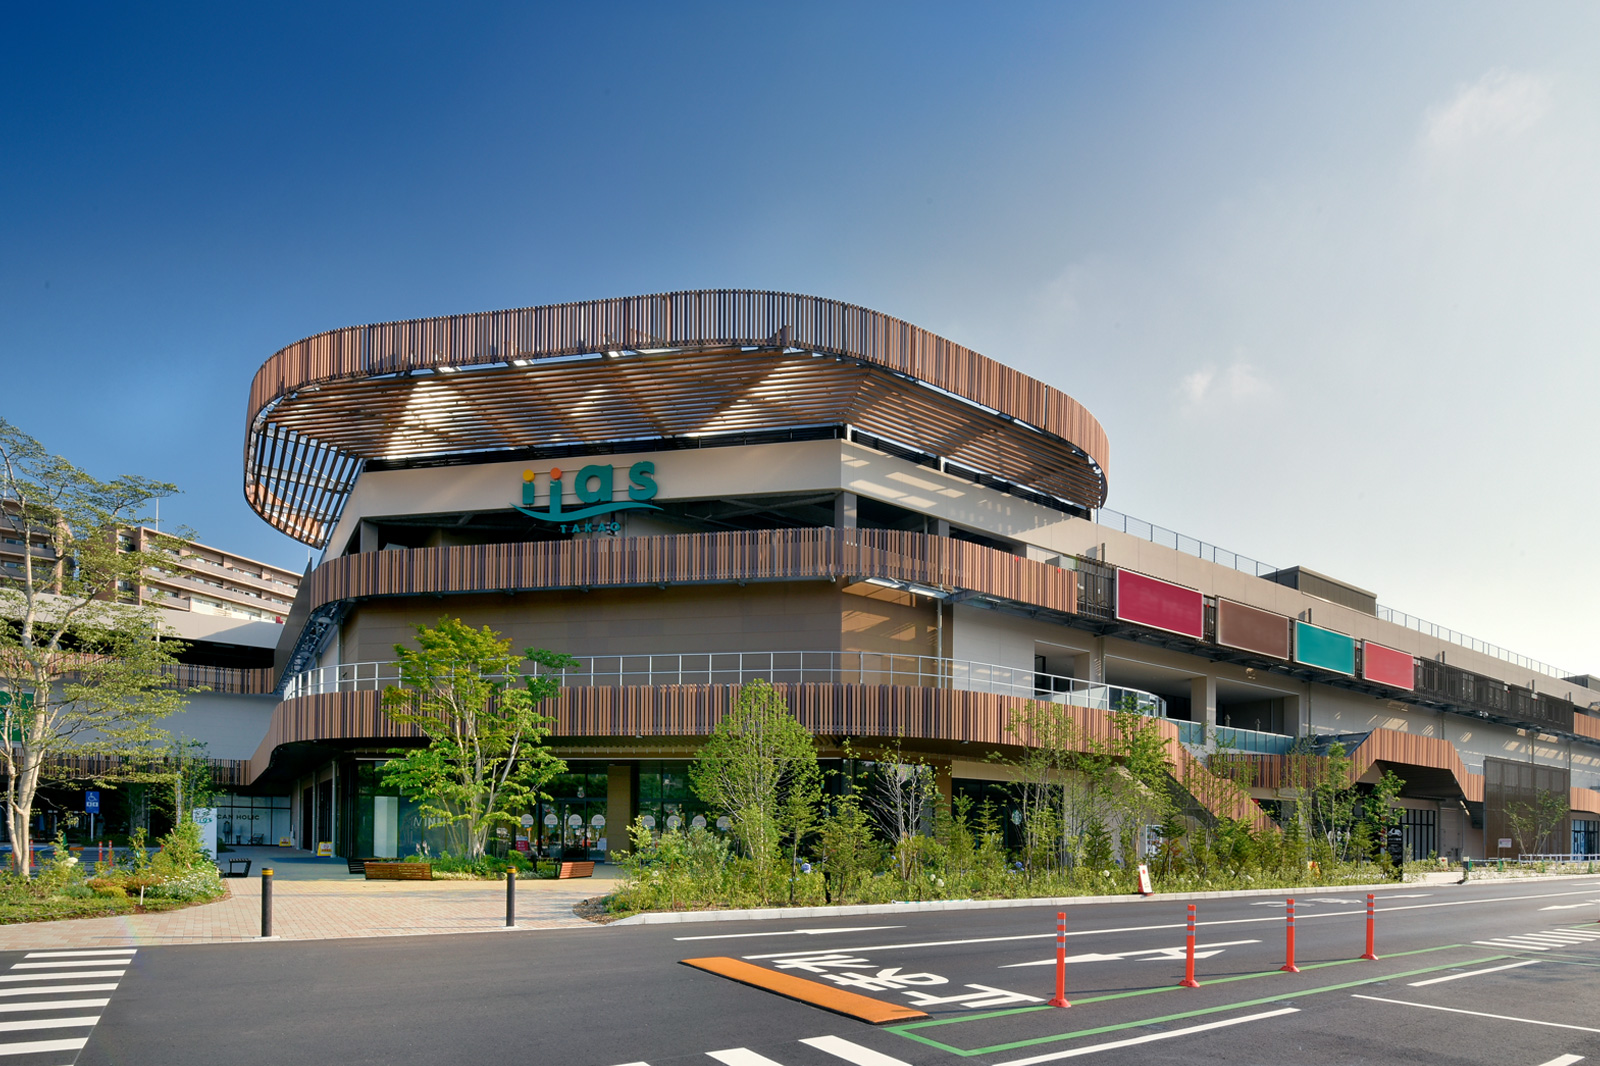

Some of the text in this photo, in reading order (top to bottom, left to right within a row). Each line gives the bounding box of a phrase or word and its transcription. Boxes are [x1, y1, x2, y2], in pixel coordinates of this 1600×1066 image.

[560, 522, 621, 534] TAKAO
[772, 954, 1046, 1008] 止まれ
